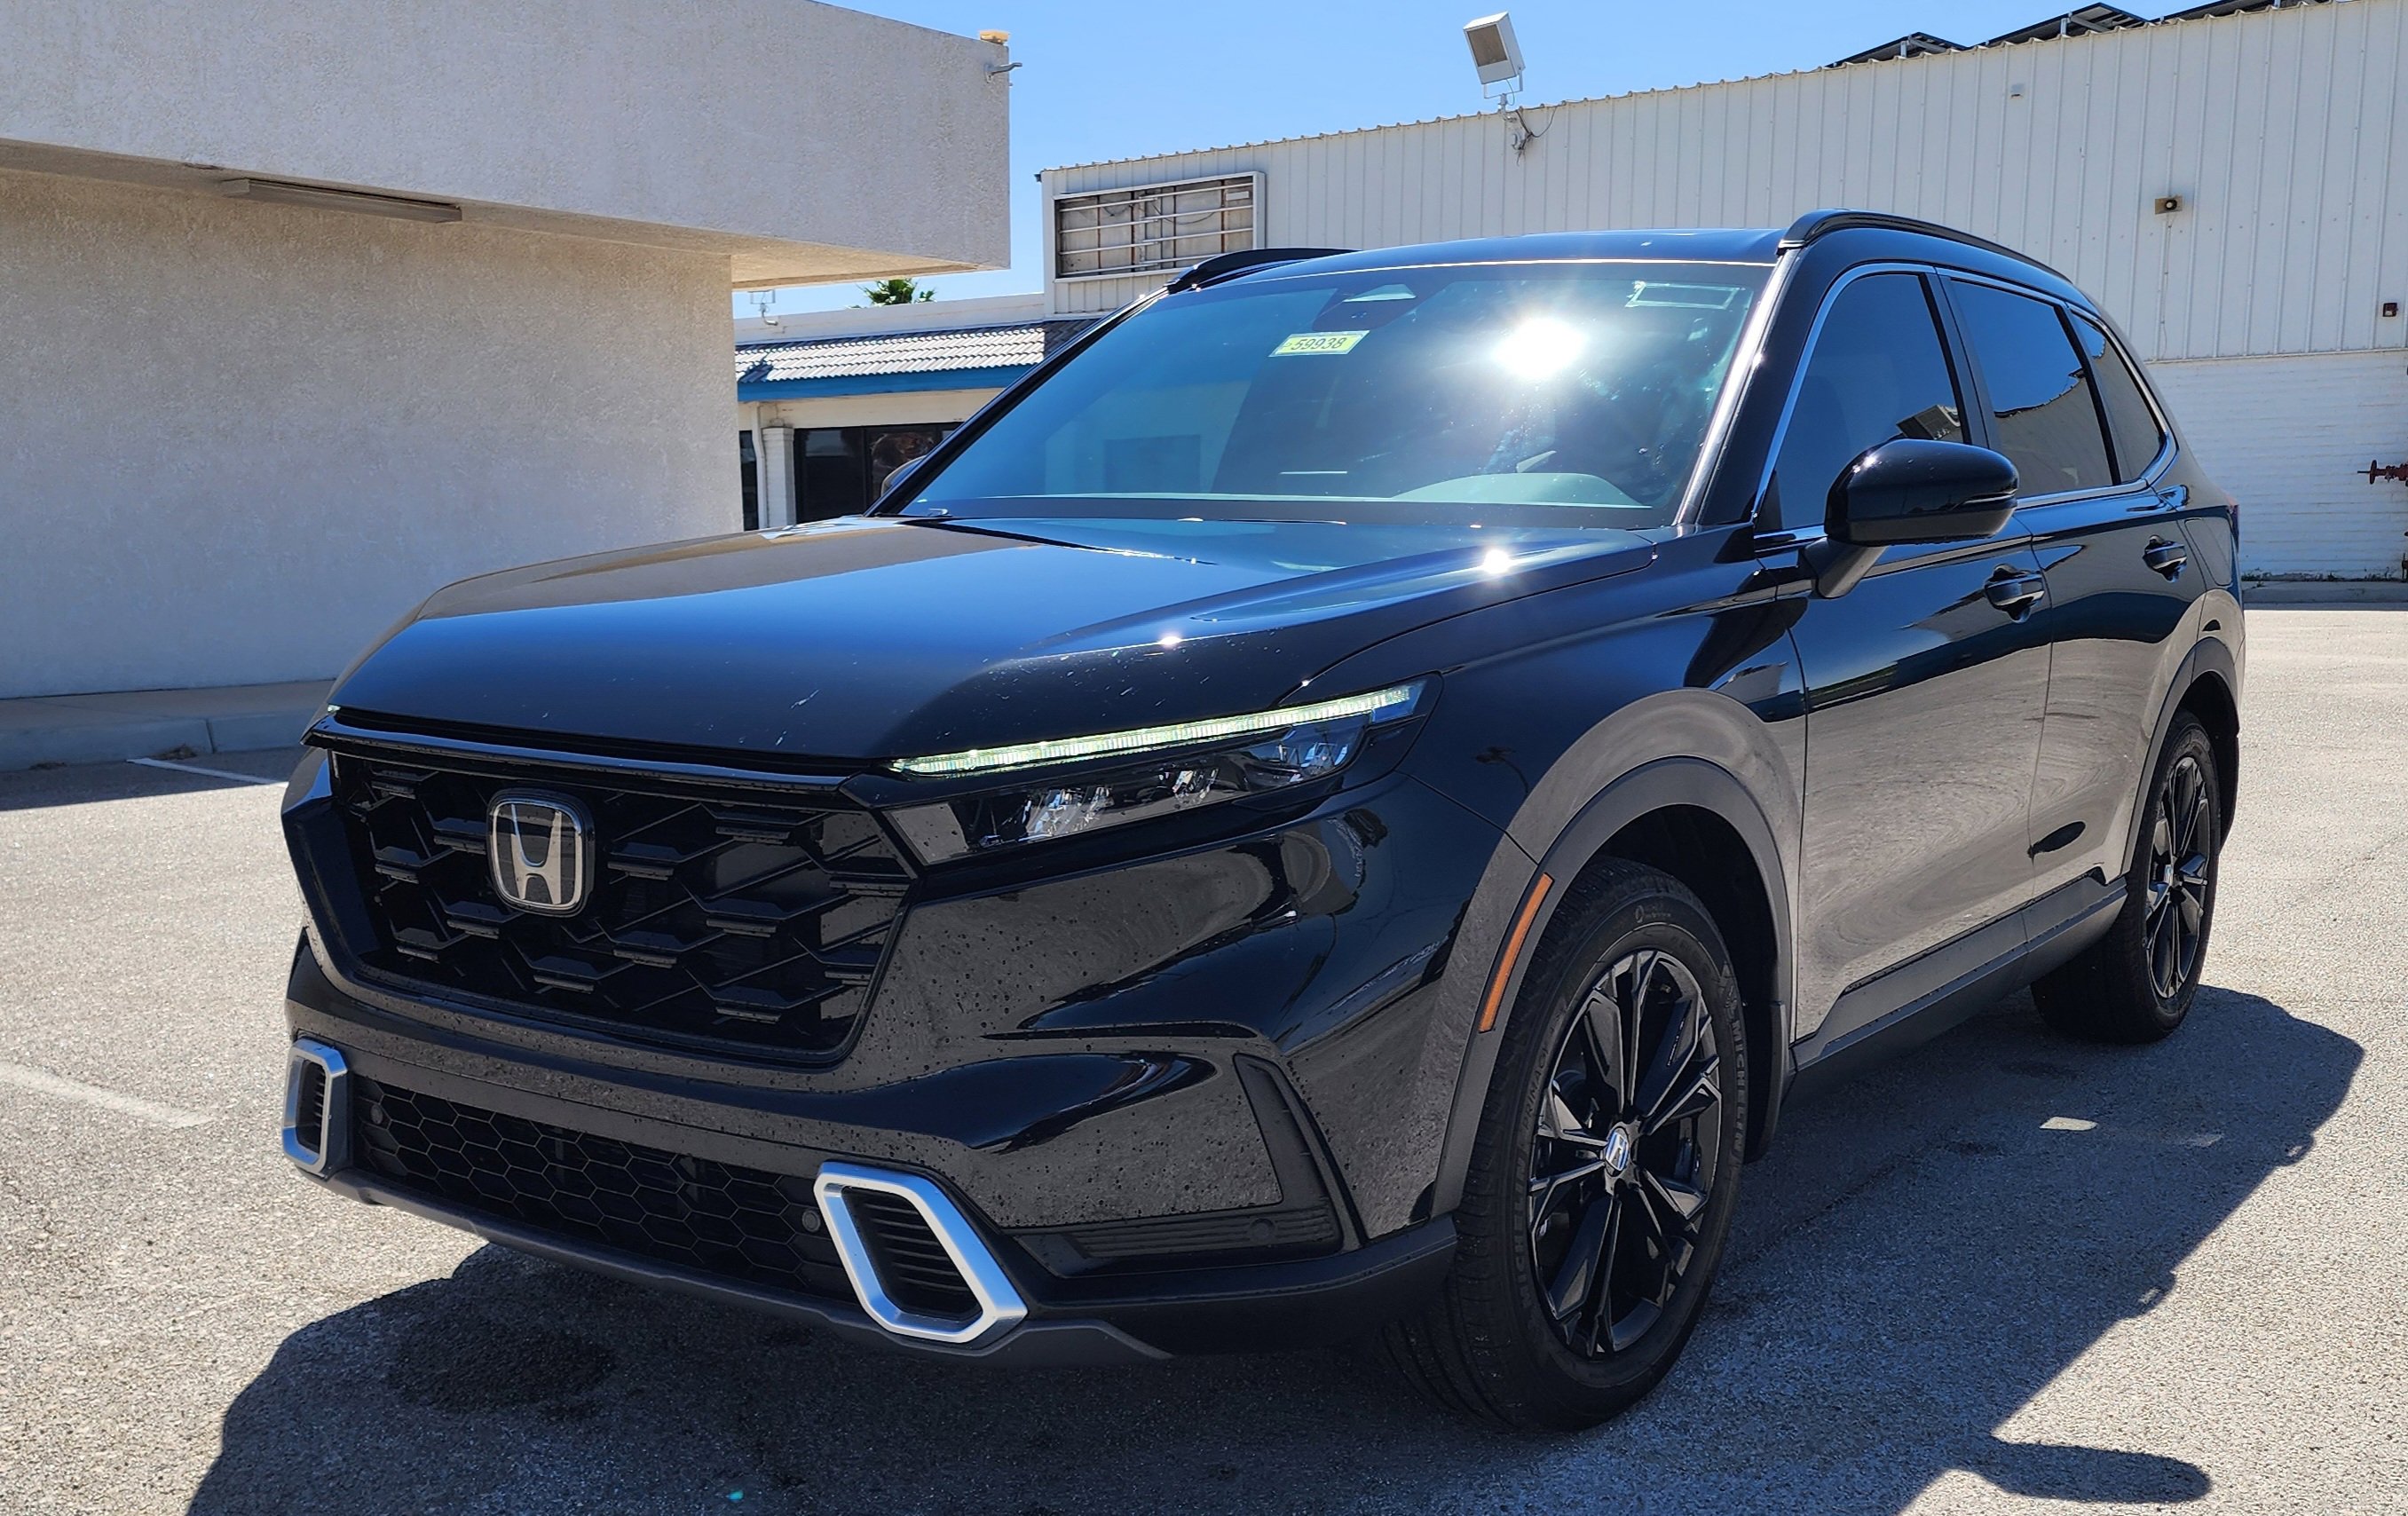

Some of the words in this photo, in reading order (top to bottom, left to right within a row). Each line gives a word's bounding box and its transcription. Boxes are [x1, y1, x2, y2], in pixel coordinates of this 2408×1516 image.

[1291, 337, 1346, 351] 59938
[1731, 1021, 1746, 1152] MICHELIN
[1513, 1157, 1533, 1309] MICHELIN
